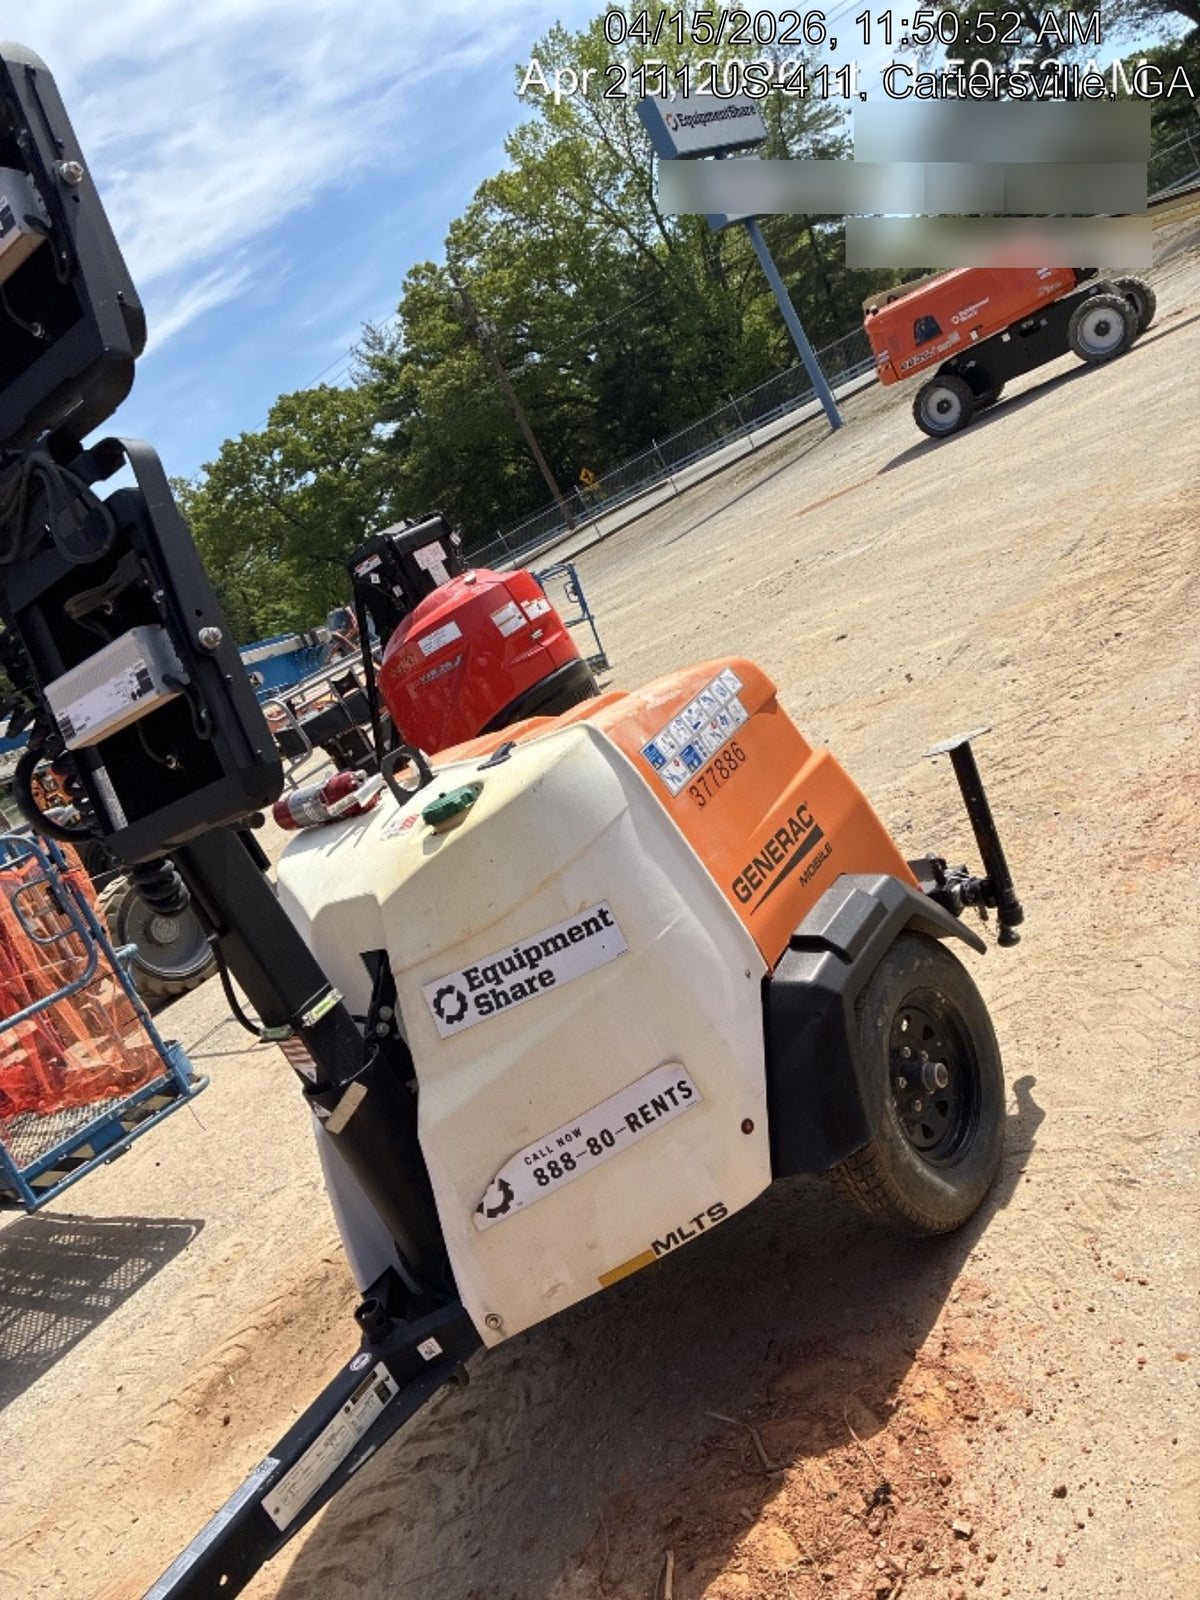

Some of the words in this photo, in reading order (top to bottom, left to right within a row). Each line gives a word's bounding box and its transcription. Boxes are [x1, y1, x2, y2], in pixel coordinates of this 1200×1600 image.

[689, 741, 747, 807] 377886
[731, 804, 815, 904] GENERAC
[798, 842, 833, 887] MOBILE
[462, 907, 615, 992] Equipment
[474, 968, 556, 1016] Share
[523, 1146, 554, 1166] CALL
[556, 1126, 583, 1147] NOW
[532, 1079, 693, 1187] 888-80-RENTS
[650, 1201, 729, 1256] MLTS
